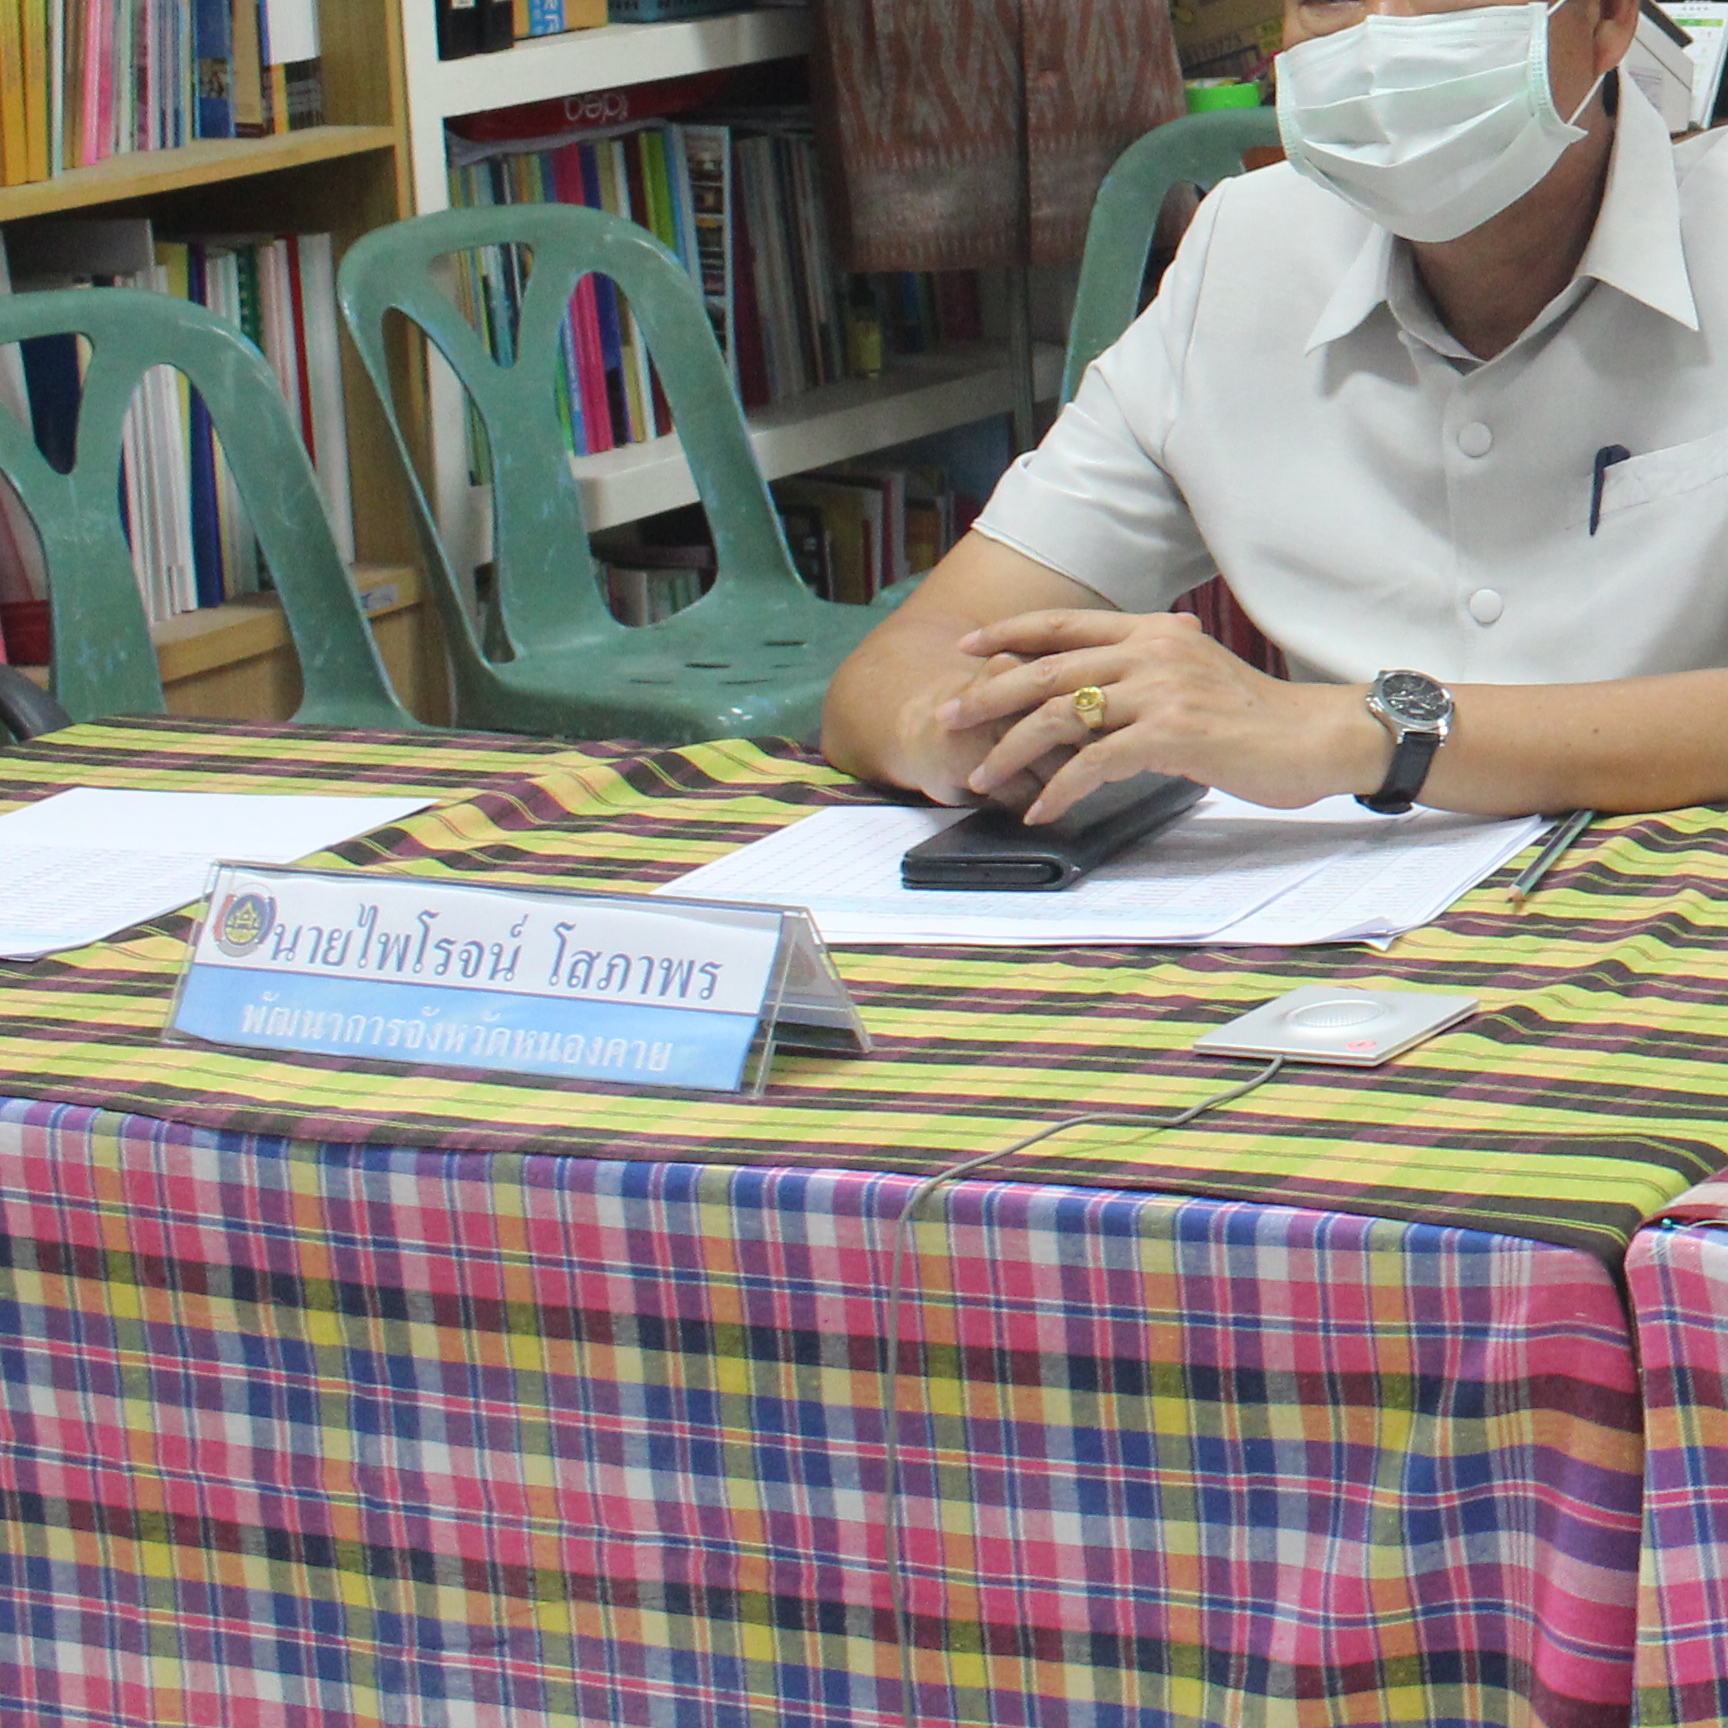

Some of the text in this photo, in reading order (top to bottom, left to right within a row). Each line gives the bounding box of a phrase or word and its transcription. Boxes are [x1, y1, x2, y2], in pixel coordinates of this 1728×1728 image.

[267, 903, 723, 1002] นายไพโรจน์ โสภาพร
[240, 991, 675, 1073] พัฒนาการจังหวัดหนองคาย
